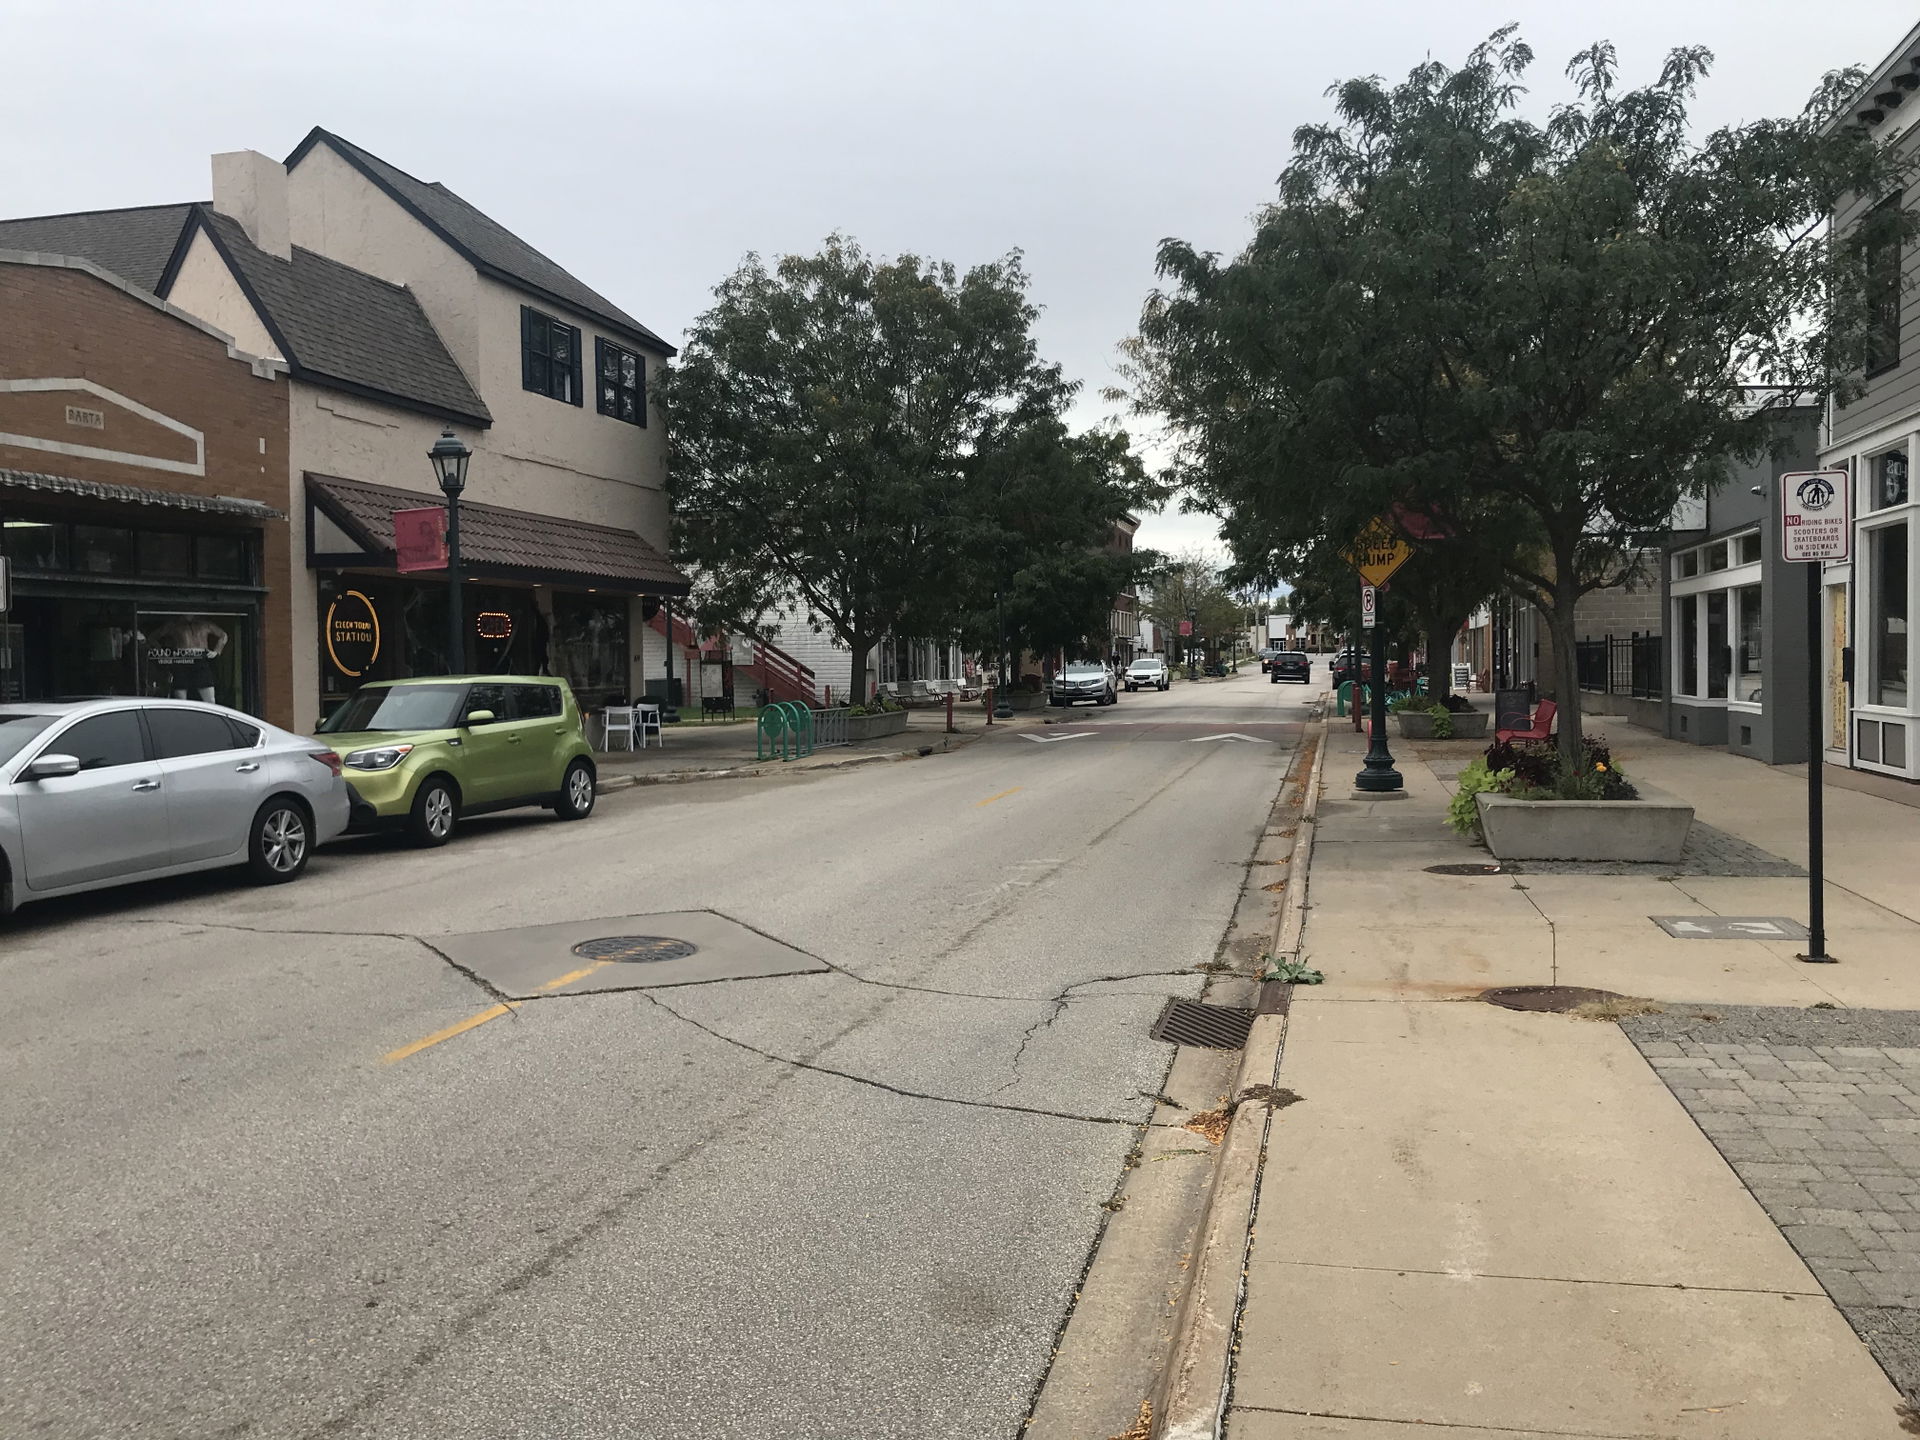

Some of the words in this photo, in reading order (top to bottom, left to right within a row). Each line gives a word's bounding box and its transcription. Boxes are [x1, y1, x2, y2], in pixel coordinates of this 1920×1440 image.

[68, 409, 101, 424] BARTA
[1786, 516, 1800, 526] NO
[1824, 517, 1843, 525] BIKES
[1793, 535, 1840, 543] SKATEBOARDS
[1805, 543, 1838, 551] SIDEWALK
[336, 631, 372, 642] STATION
